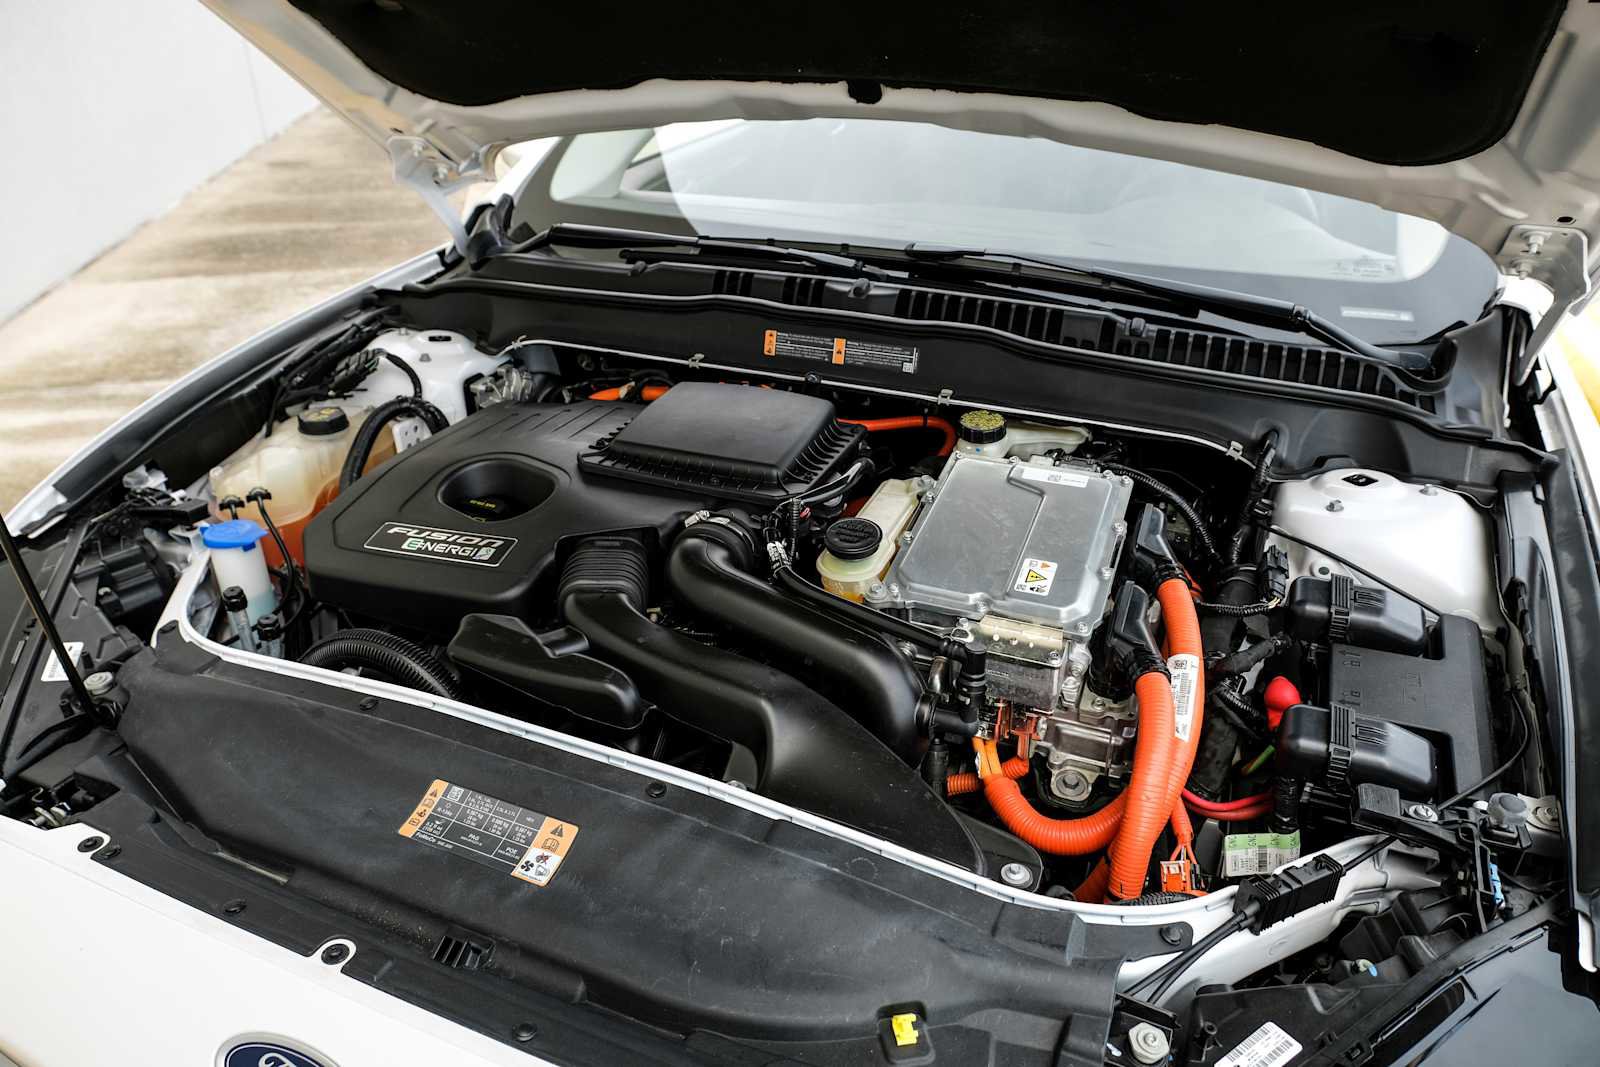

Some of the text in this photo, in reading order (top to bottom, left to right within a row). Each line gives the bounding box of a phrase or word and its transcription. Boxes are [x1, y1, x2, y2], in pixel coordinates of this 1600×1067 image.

[387, 527, 504, 547] FUSION
[401, 538, 477, 557] ENERGI
[467, 833, 480, 841] PAG
[1248, 835, 1257, 846] GNC
[505, 846, 518, 854] POE
